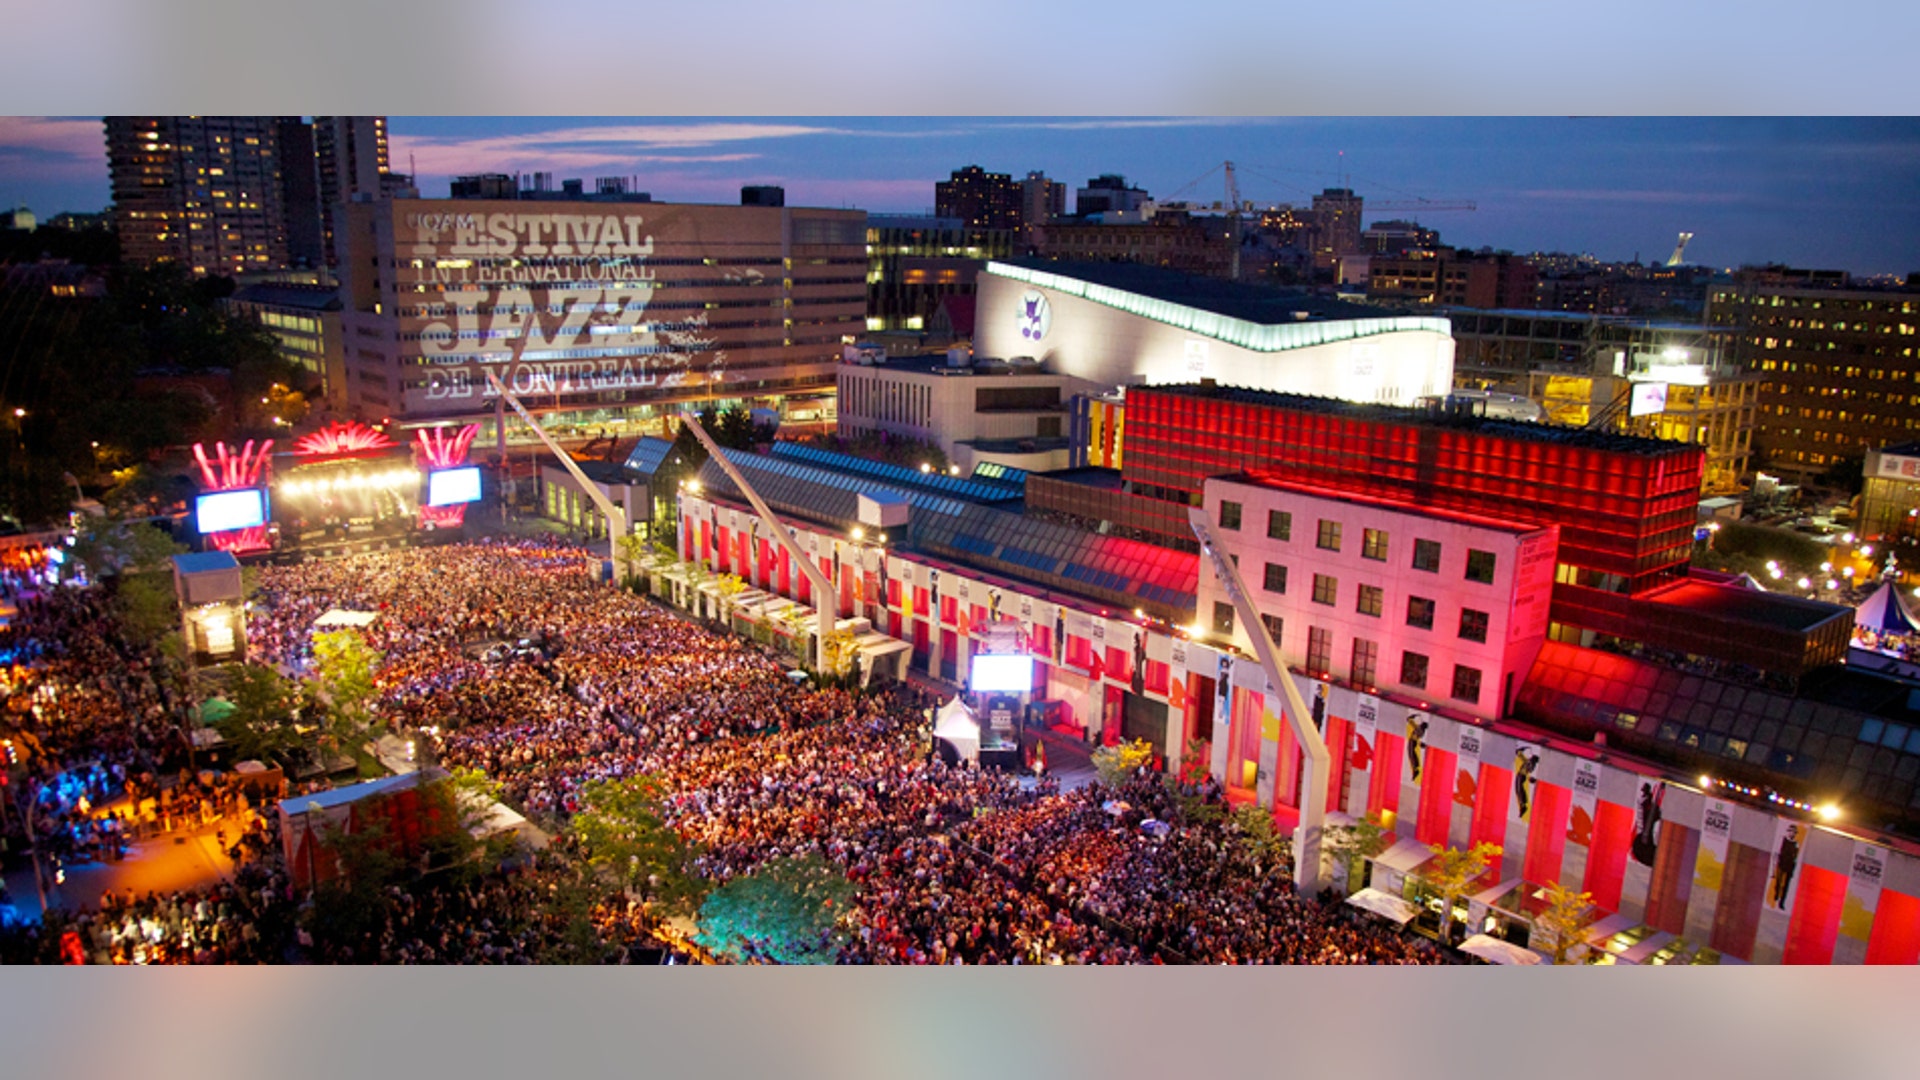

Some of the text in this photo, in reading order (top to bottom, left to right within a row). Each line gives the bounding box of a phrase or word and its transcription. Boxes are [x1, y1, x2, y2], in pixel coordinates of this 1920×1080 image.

[411, 212, 654, 255] FESTIVAL
[413, 256, 656, 284] INTERNATIONAL
[420, 285, 657, 366] JAZZ
[422, 366, 473, 400] DE
